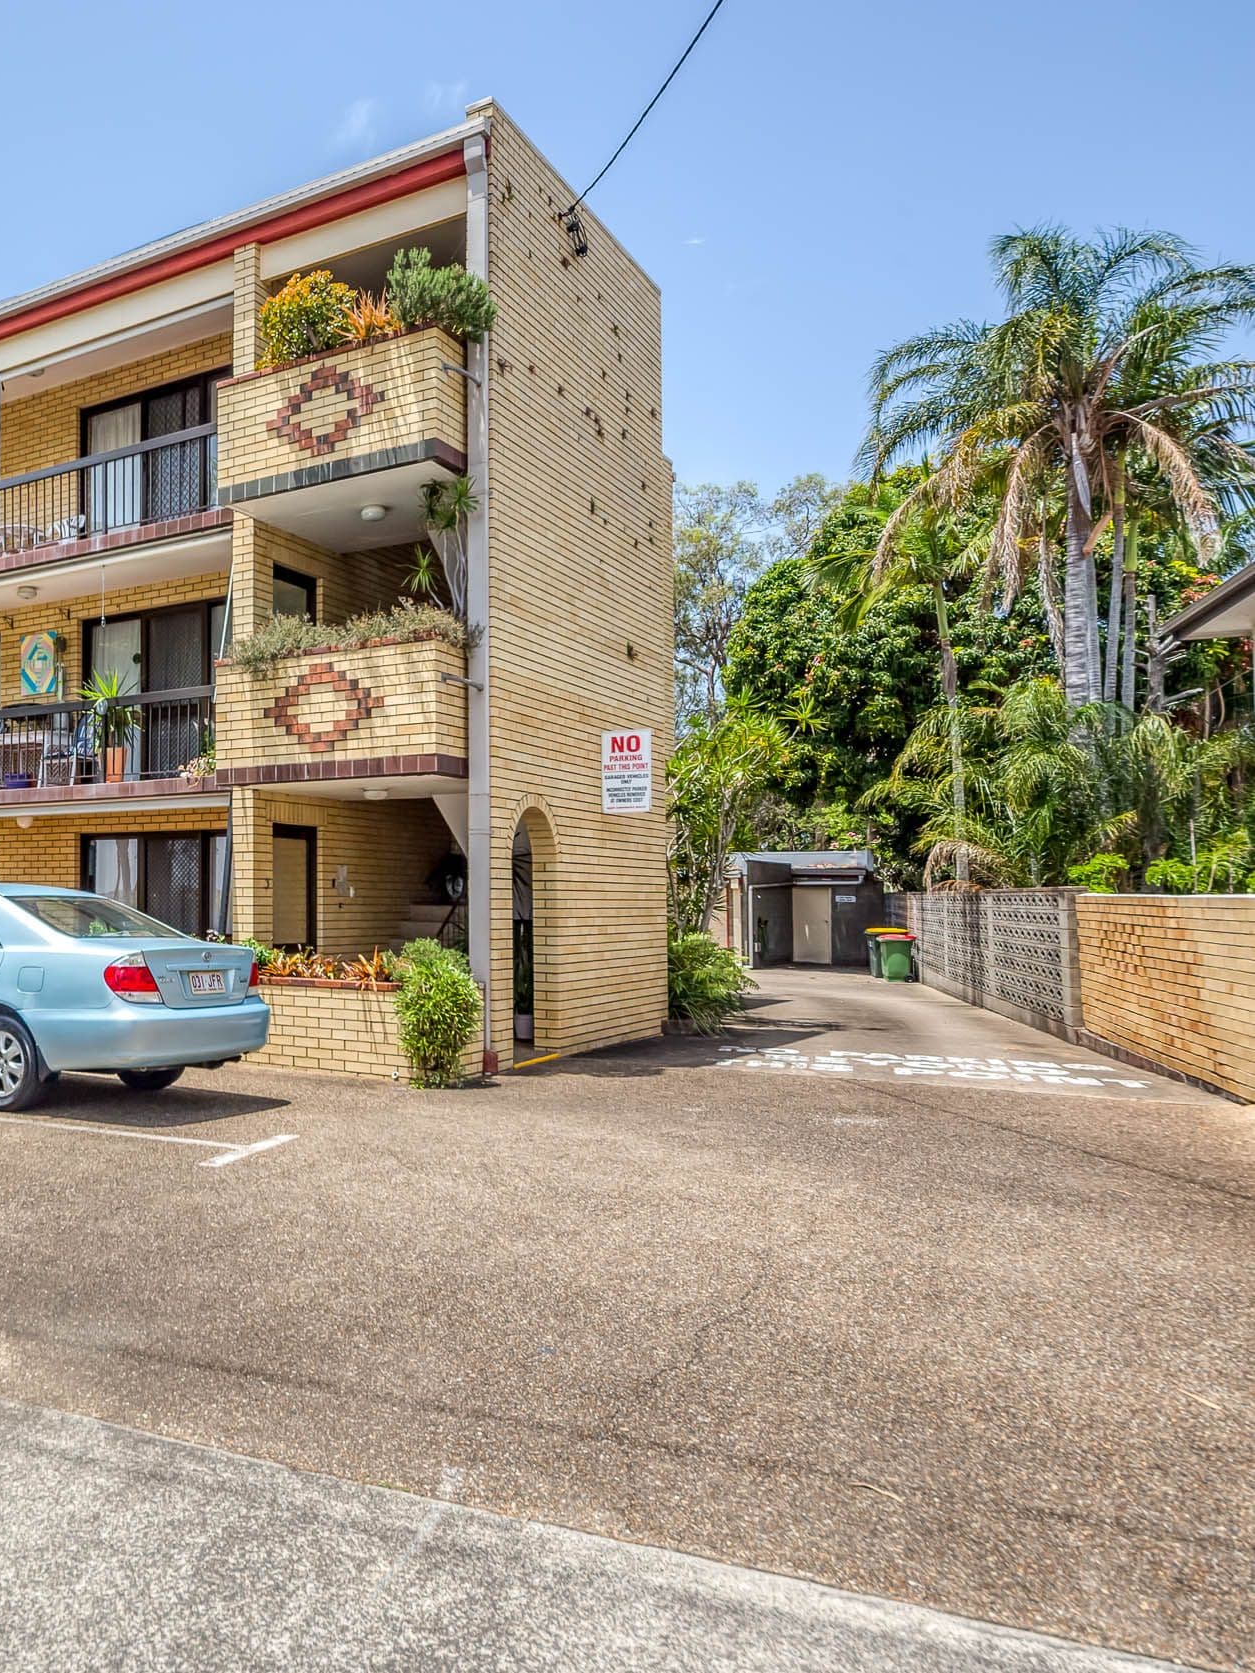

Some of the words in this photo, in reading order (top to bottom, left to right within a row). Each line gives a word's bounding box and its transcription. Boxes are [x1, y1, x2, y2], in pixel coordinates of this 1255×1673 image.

[611, 735, 641, 753] NO
[609, 754, 643, 762] PARKING
[632, 762, 648, 770] POINT
[191, 975, 205, 988] 031
[208, 974, 223, 987] JFR
[894, 1067, 1152, 1088] POINT
